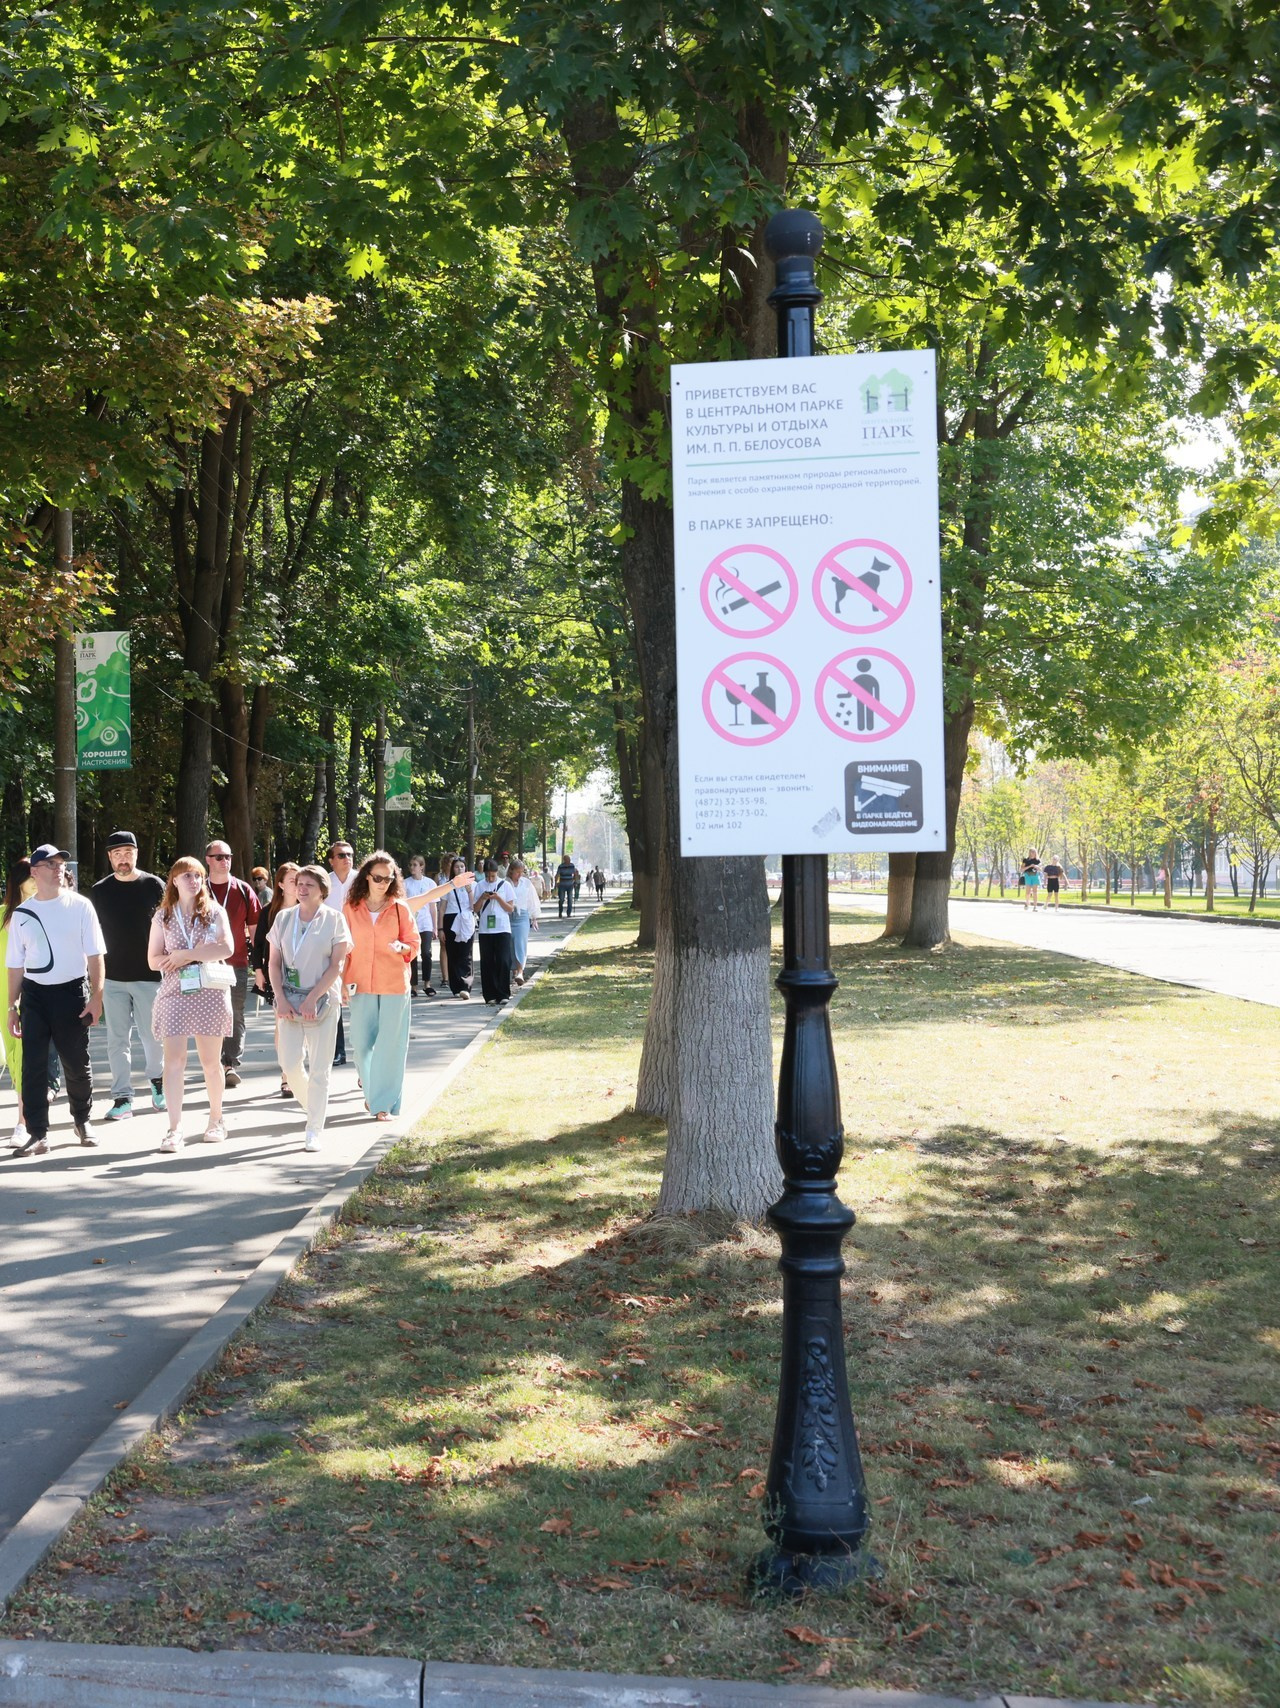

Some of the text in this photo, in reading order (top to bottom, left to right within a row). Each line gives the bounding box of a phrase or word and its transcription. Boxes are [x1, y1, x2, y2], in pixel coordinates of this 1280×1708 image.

[685, 382, 817, 401] ПРИВЕТСТВУЕМ ВАС
[685, 399, 844, 419] В ЦЕНТРАЛЬНОМ ПАРКЕ
[686, 418, 829, 437] КУЛЬТУРЫ И ОТДЫХА
[862, 424, 914, 440] ПАРК
[686, 437, 822, 455] ИМ. П. П. БЕЛОУСОВА
[687, 467, 908, 486] Парк является памятником природы регионального
[688, 488, 726, 497] значения
[734, 486, 759, 495] особо
[761, 482, 813, 495] охраняемой
[815, 480, 862, 492] природной
[864, 477, 922, 489] территорией.
[688, 513, 833, 532] В ПАРКЕ ЗАПРЕЩЕНО:
[82, 750, 128, 758] ХОРОШЕГО
[81, 758, 128, 767] НАСТРОЕНИЯ!
[857, 763, 909, 773] ВНИМАНИЕ!
[694, 774, 714, 783] Если
[729, 774, 753, 782] стали
[755, 772, 806, 782] свидетелем
[694, 785, 767, 795] правонарушения
[776, 783, 814, 793] звонить:
[695, 797, 723, 808] (4872)
[695, 809, 723, 819] (4872)
[884, 811, 913, 819] ВЕДЁТСЯ
[695, 821, 742, 830] 02 или 102
[851, 820, 918, 828] ВИДЕОНАБЛЮДЕНИЕ
